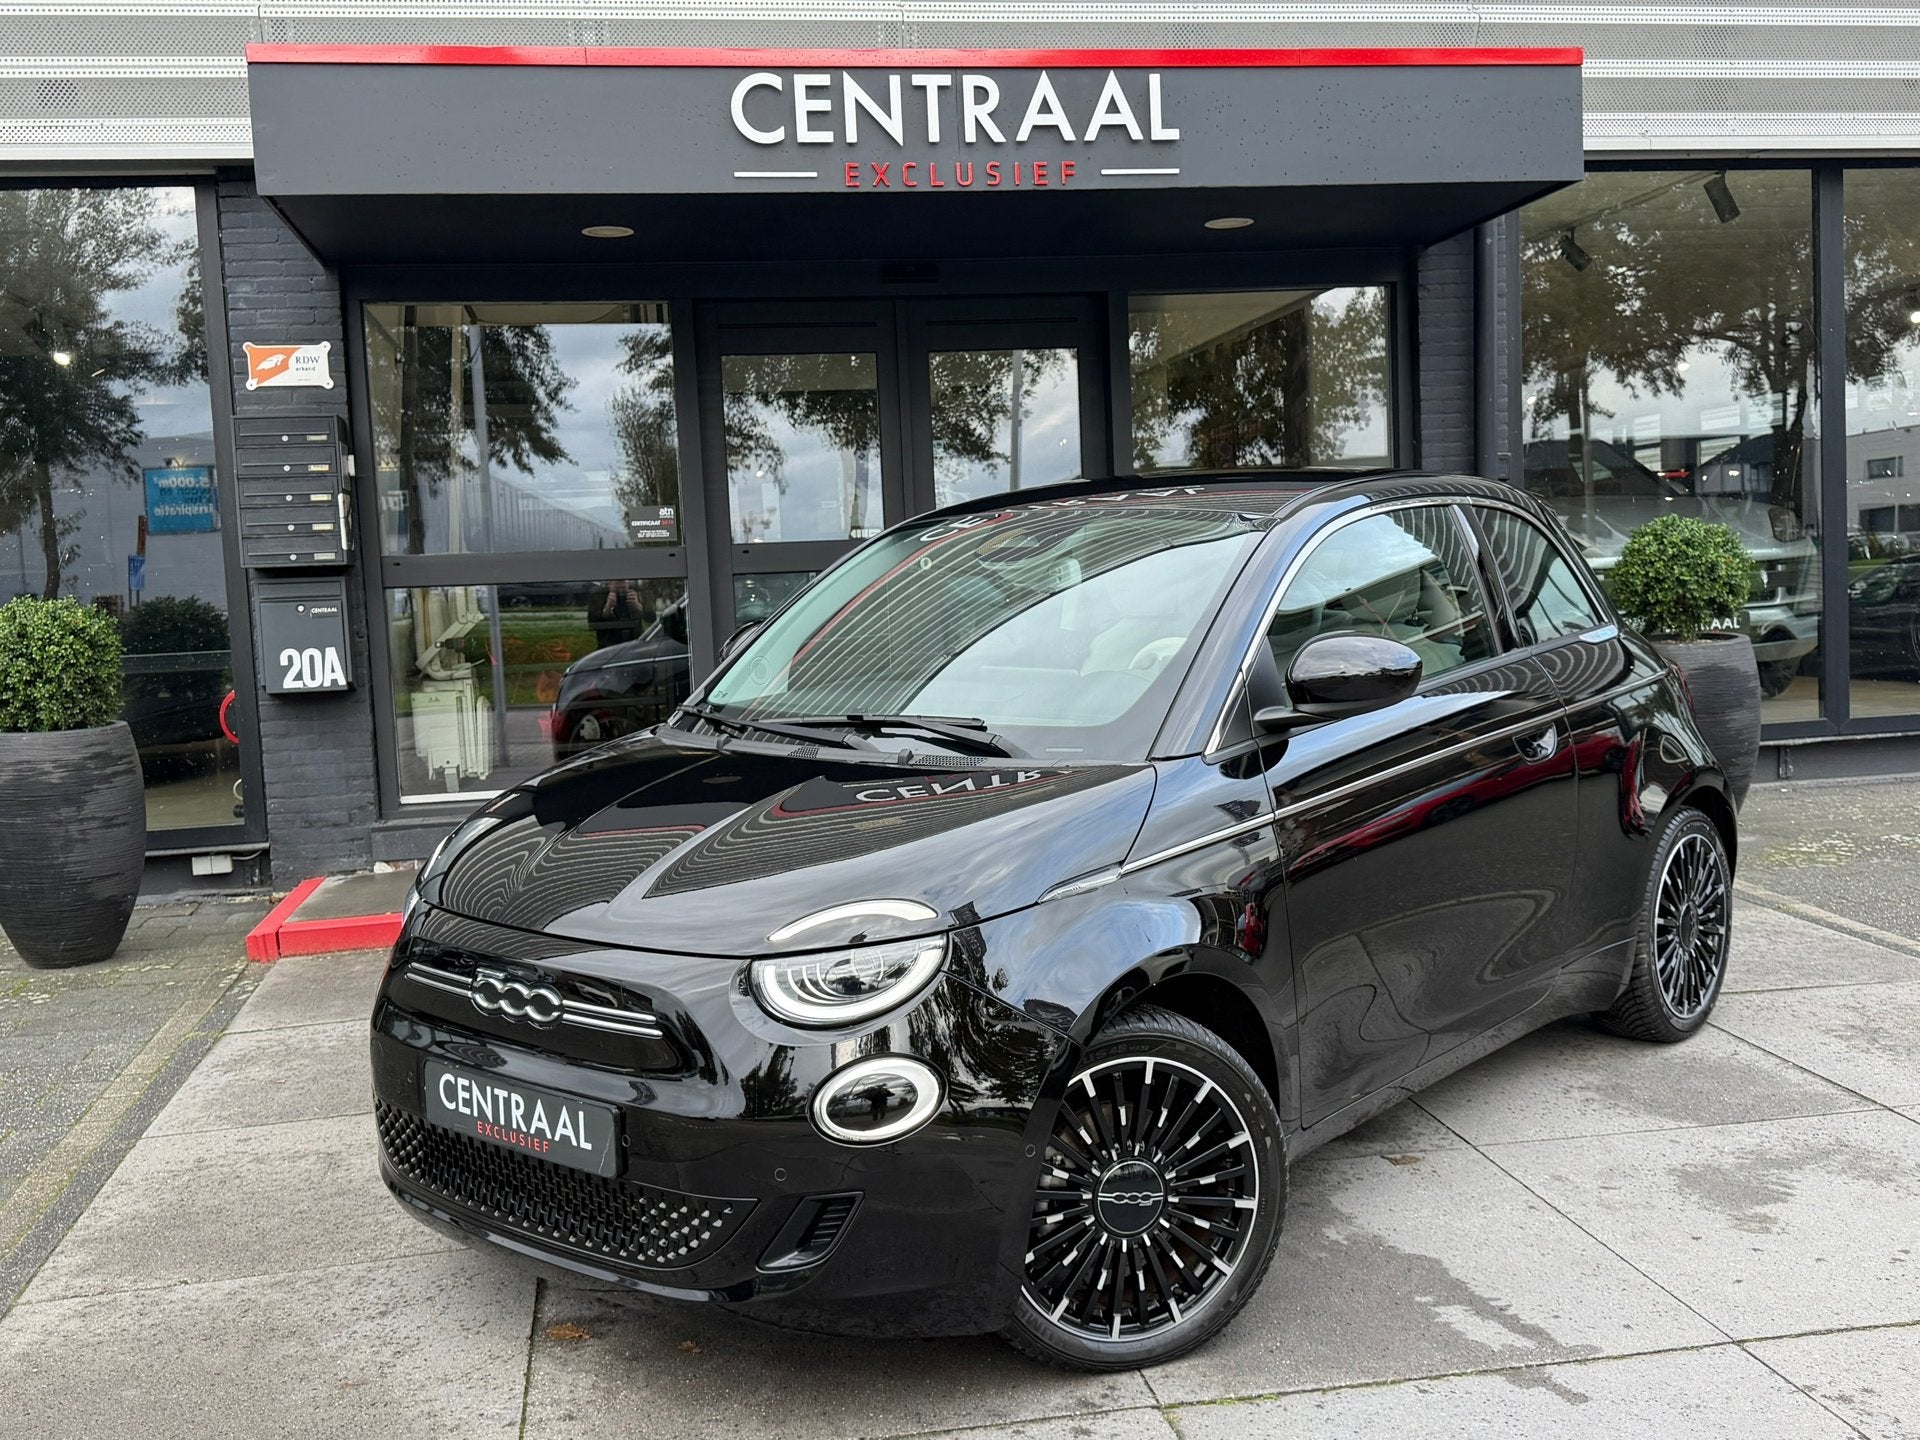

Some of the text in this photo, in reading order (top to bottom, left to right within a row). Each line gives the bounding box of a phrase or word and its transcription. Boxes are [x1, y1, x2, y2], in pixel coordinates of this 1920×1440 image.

[730, 69, 1181, 147] CENTRAAL
[844, 161, 1078, 188] EXCLUSIEF
[295, 355, 321, 365] RDW
[279, 646, 348, 690] 20A
[438, 1072, 593, 1151] CENTRAAL
[476, 1120, 551, 1153] EXCLUSIEF
